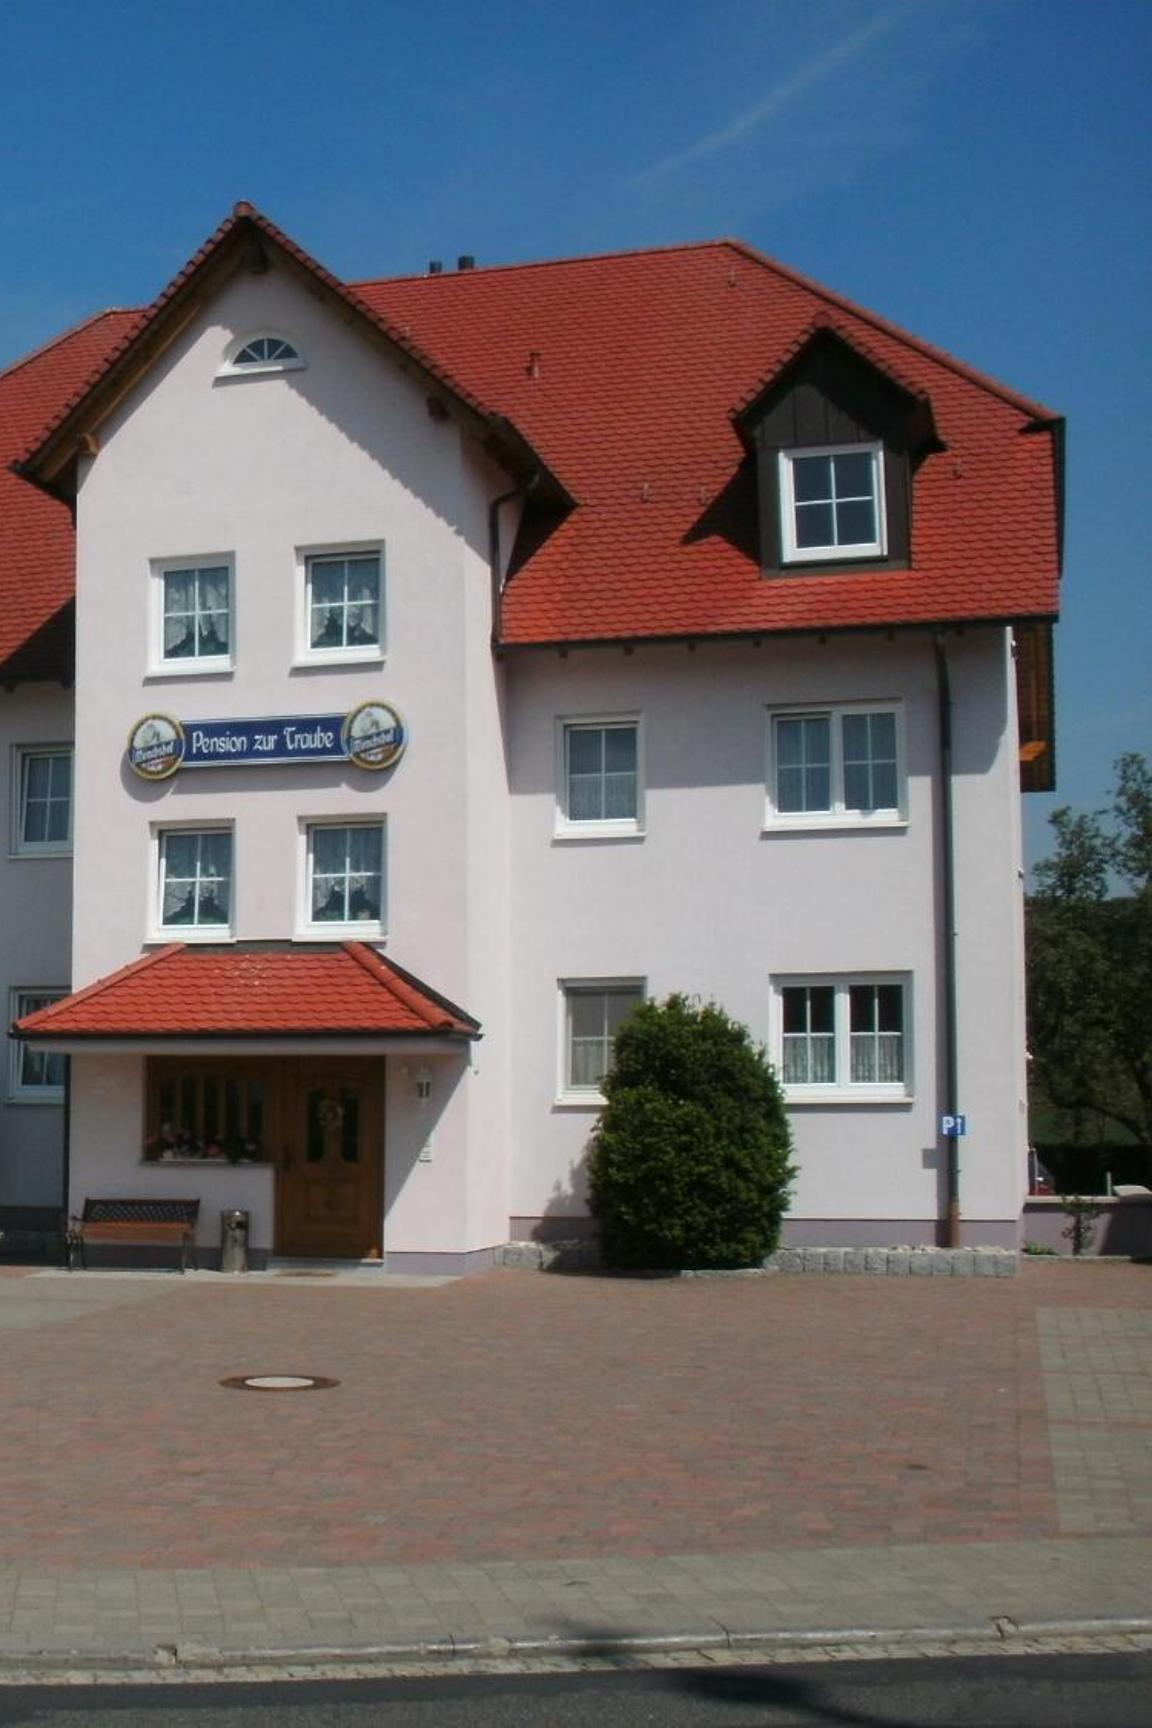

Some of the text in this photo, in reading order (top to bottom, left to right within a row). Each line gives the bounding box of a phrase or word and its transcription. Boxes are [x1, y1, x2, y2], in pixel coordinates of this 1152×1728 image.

[192, 726, 334, 754] Pension zur Traube
[942, 1115, 955, 1135] P
